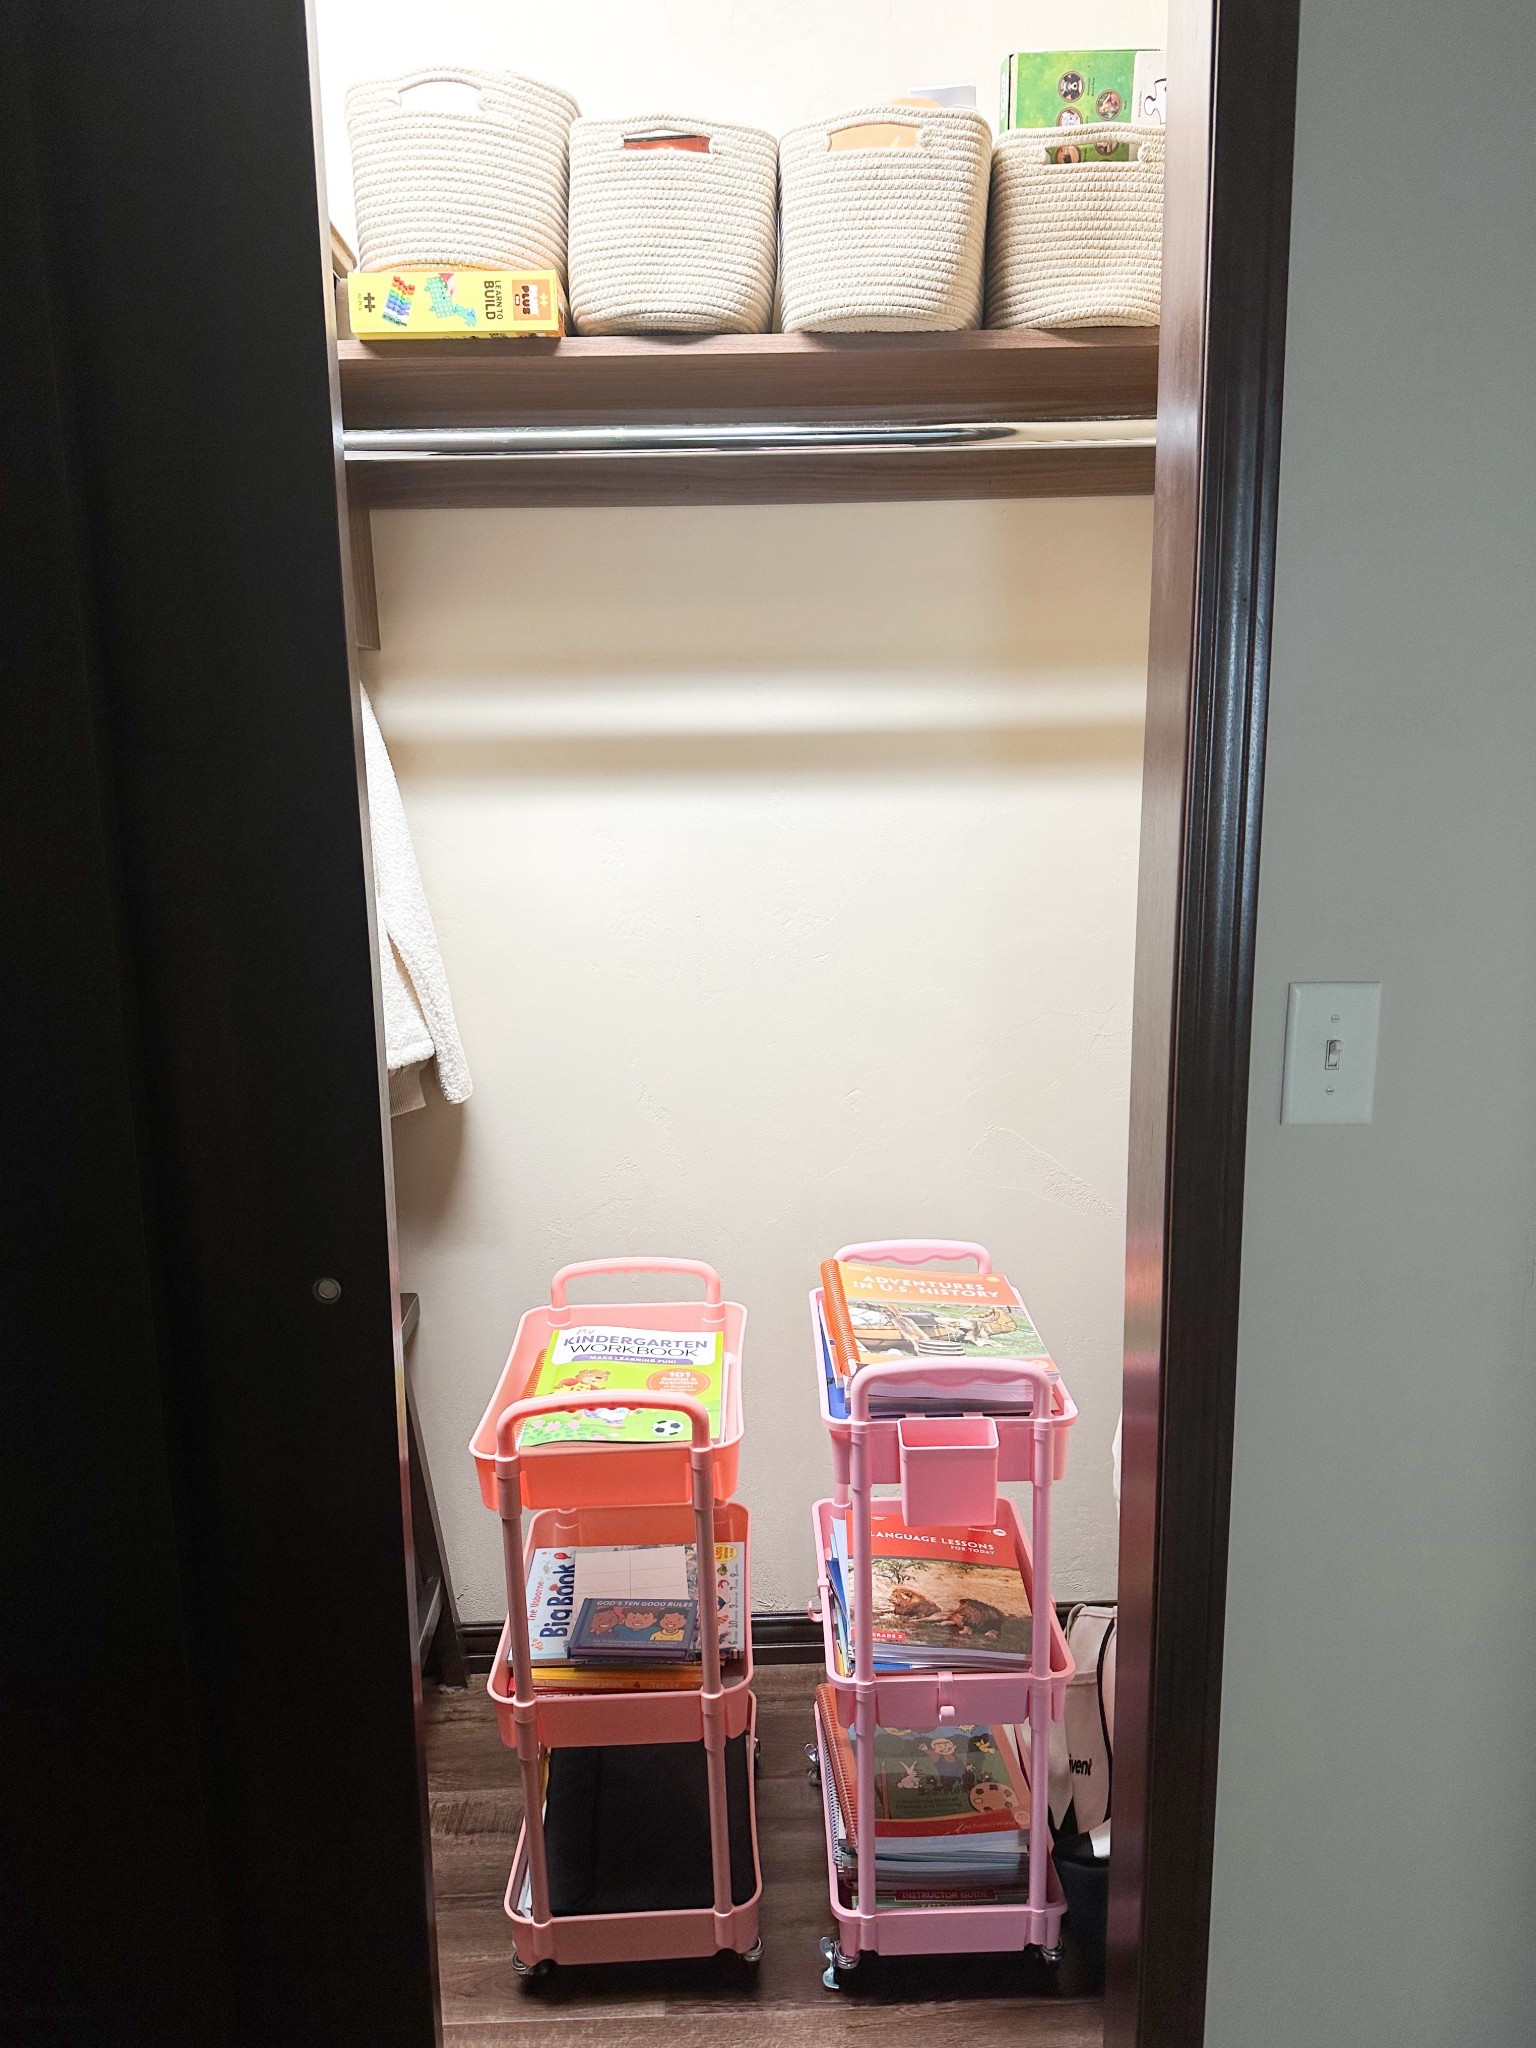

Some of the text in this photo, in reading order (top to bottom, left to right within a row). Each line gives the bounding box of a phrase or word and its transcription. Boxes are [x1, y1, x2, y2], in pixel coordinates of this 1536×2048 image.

[484, 280, 496, 320] BUILD
[494, 280, 504, 320] LEARN TO
[852, 1280, 1000, 1298] IN U.S. HISTORY
[863, 1275, 985, 1291] ADVENTURES
[563, 1335, 708, 1348] KINDERGARTEN
[570, 1344, 699, 1357] WORKBOOK
[870, 1530, 995, 1551] LANGUAGE LESSONS
[967, 1546, 995, 1555] TODAY
[540, 1564, 575, 1637] Big Book
[901, 1890, 989, 1899] INSTRUCTOR GUIDE
